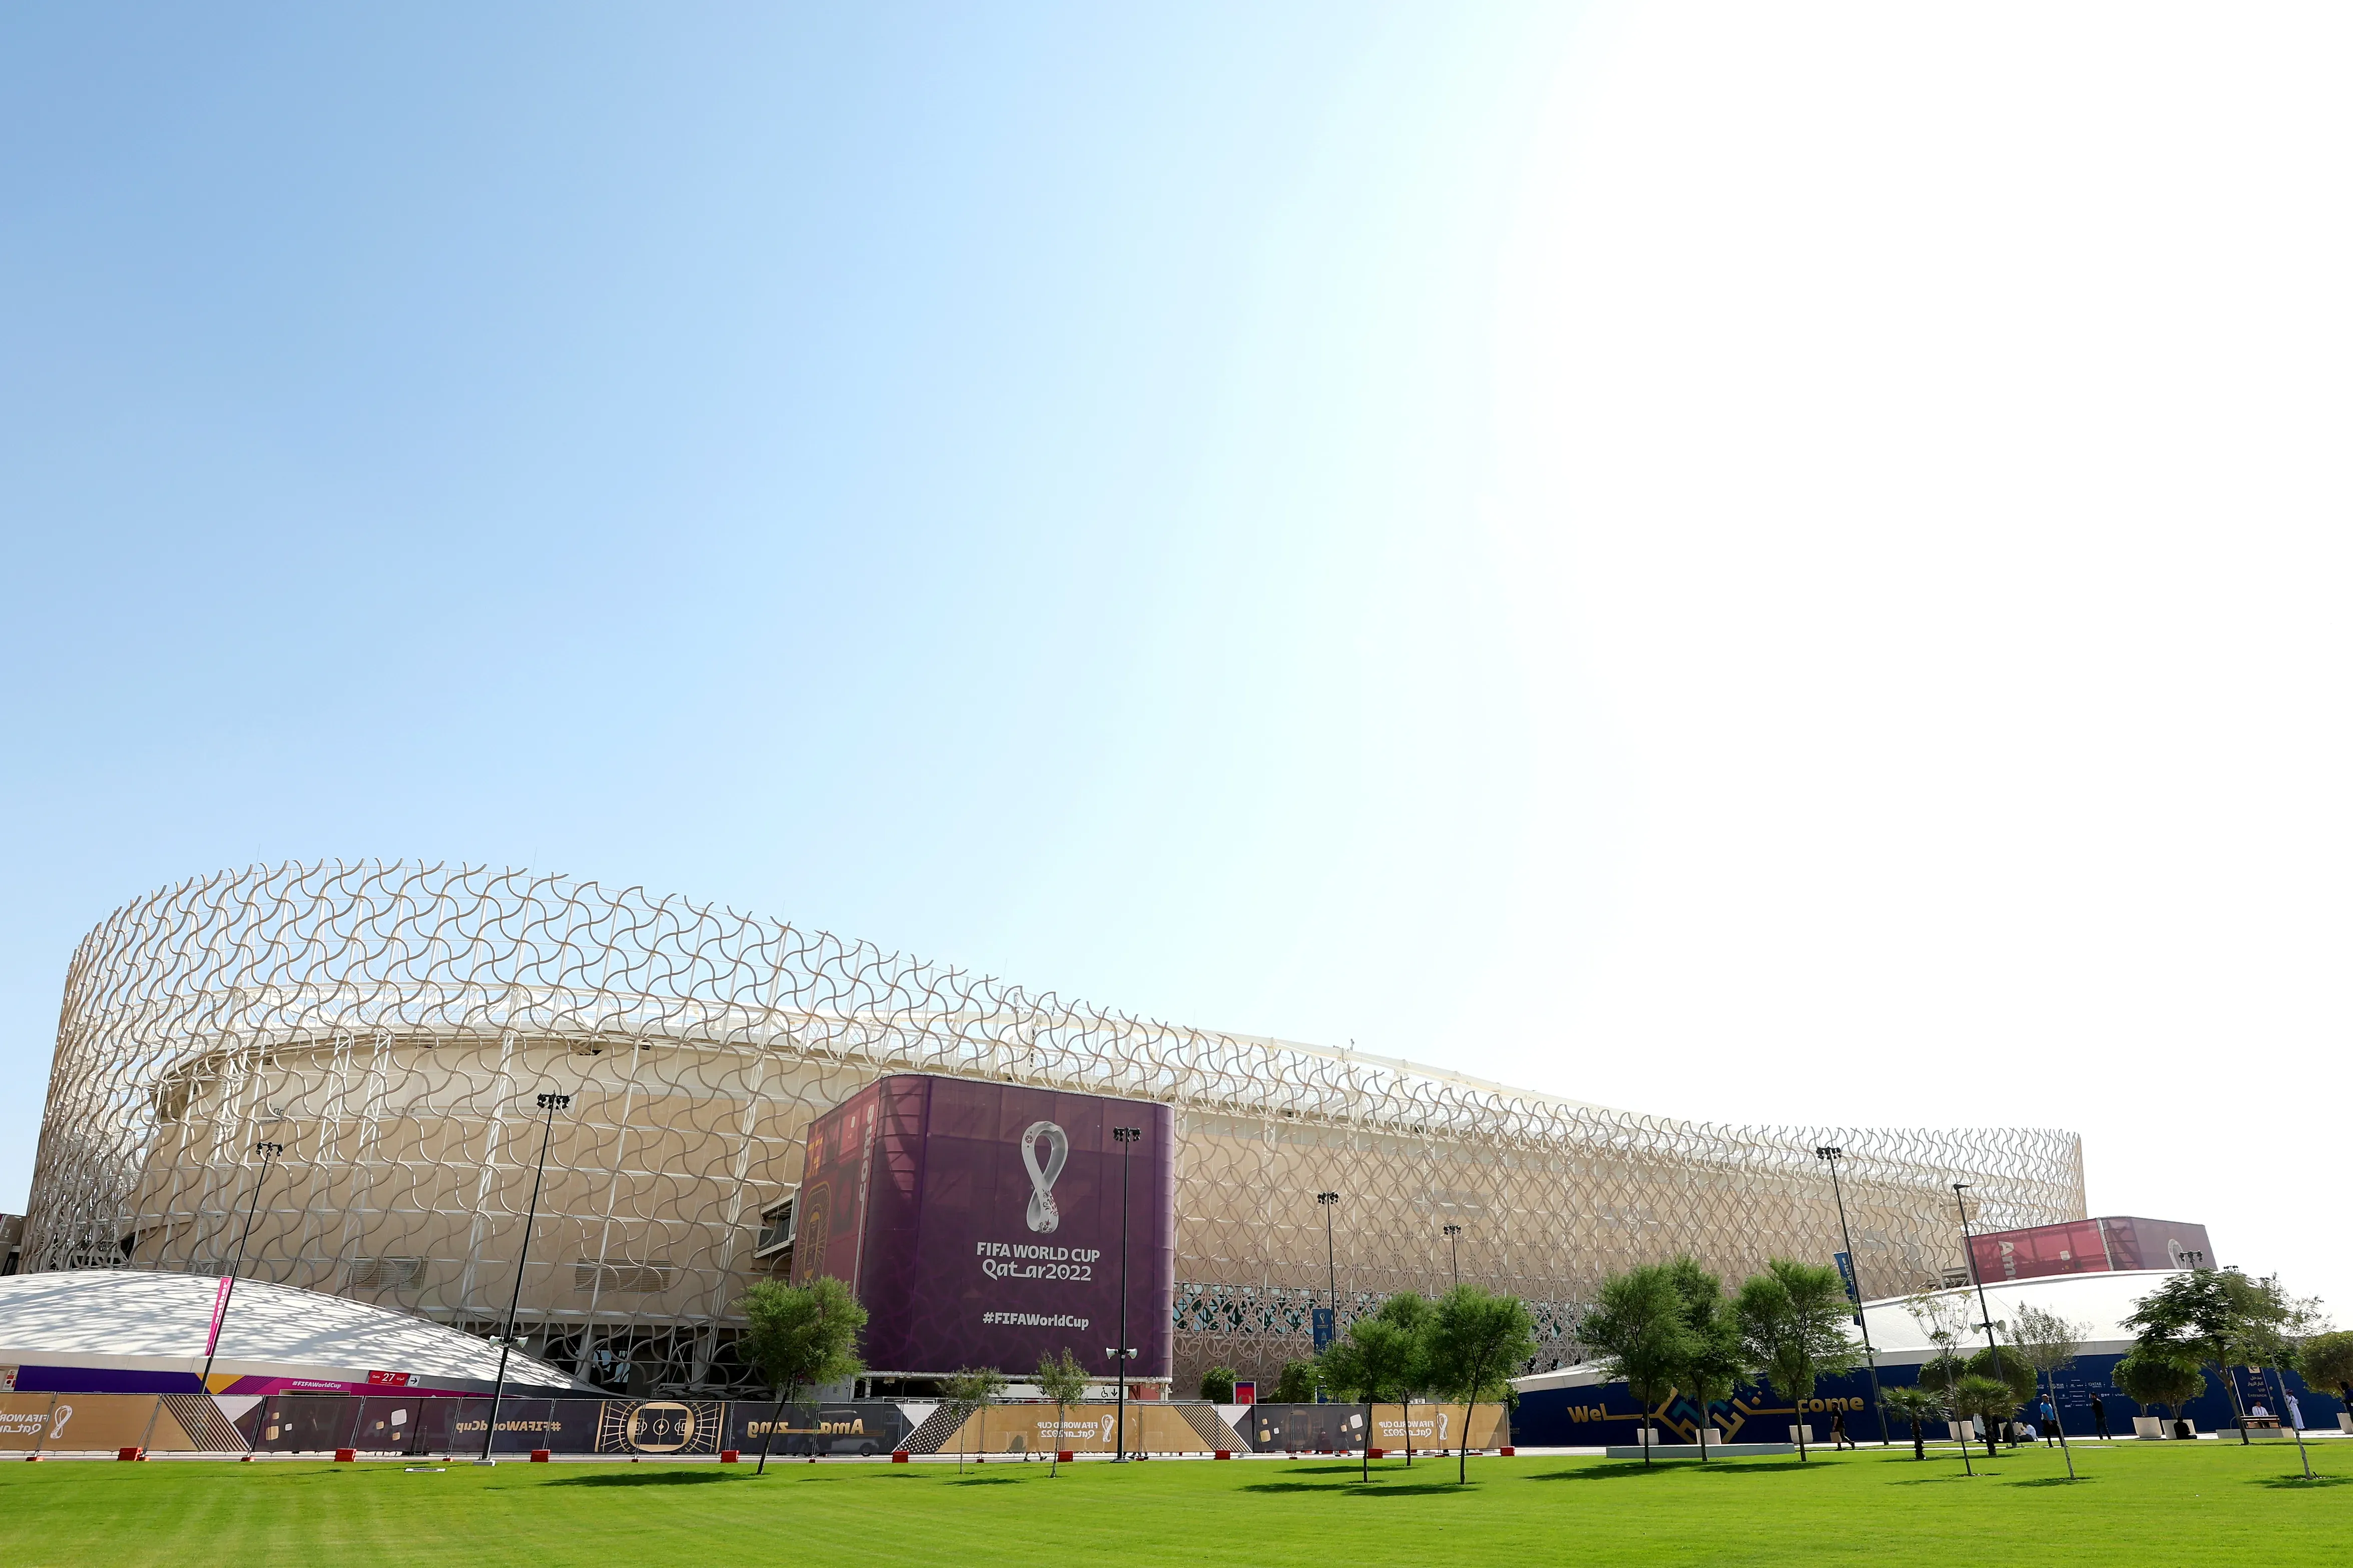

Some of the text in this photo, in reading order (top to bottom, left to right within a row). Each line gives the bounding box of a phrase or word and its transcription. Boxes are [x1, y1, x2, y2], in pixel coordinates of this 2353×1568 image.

[977, 1242, 1100, 1263] FIFA WORLD CUP
[982, 1259, 1092, 1281] Qatar2022
[983, 1312, 1089, 1331] #FIFAWorldCup
[292, 1381, 341, 1389] #FIFAWorldCup
[381, 1373, 395, 1382] 27
[1798, 1397, 1864, 1413] come
